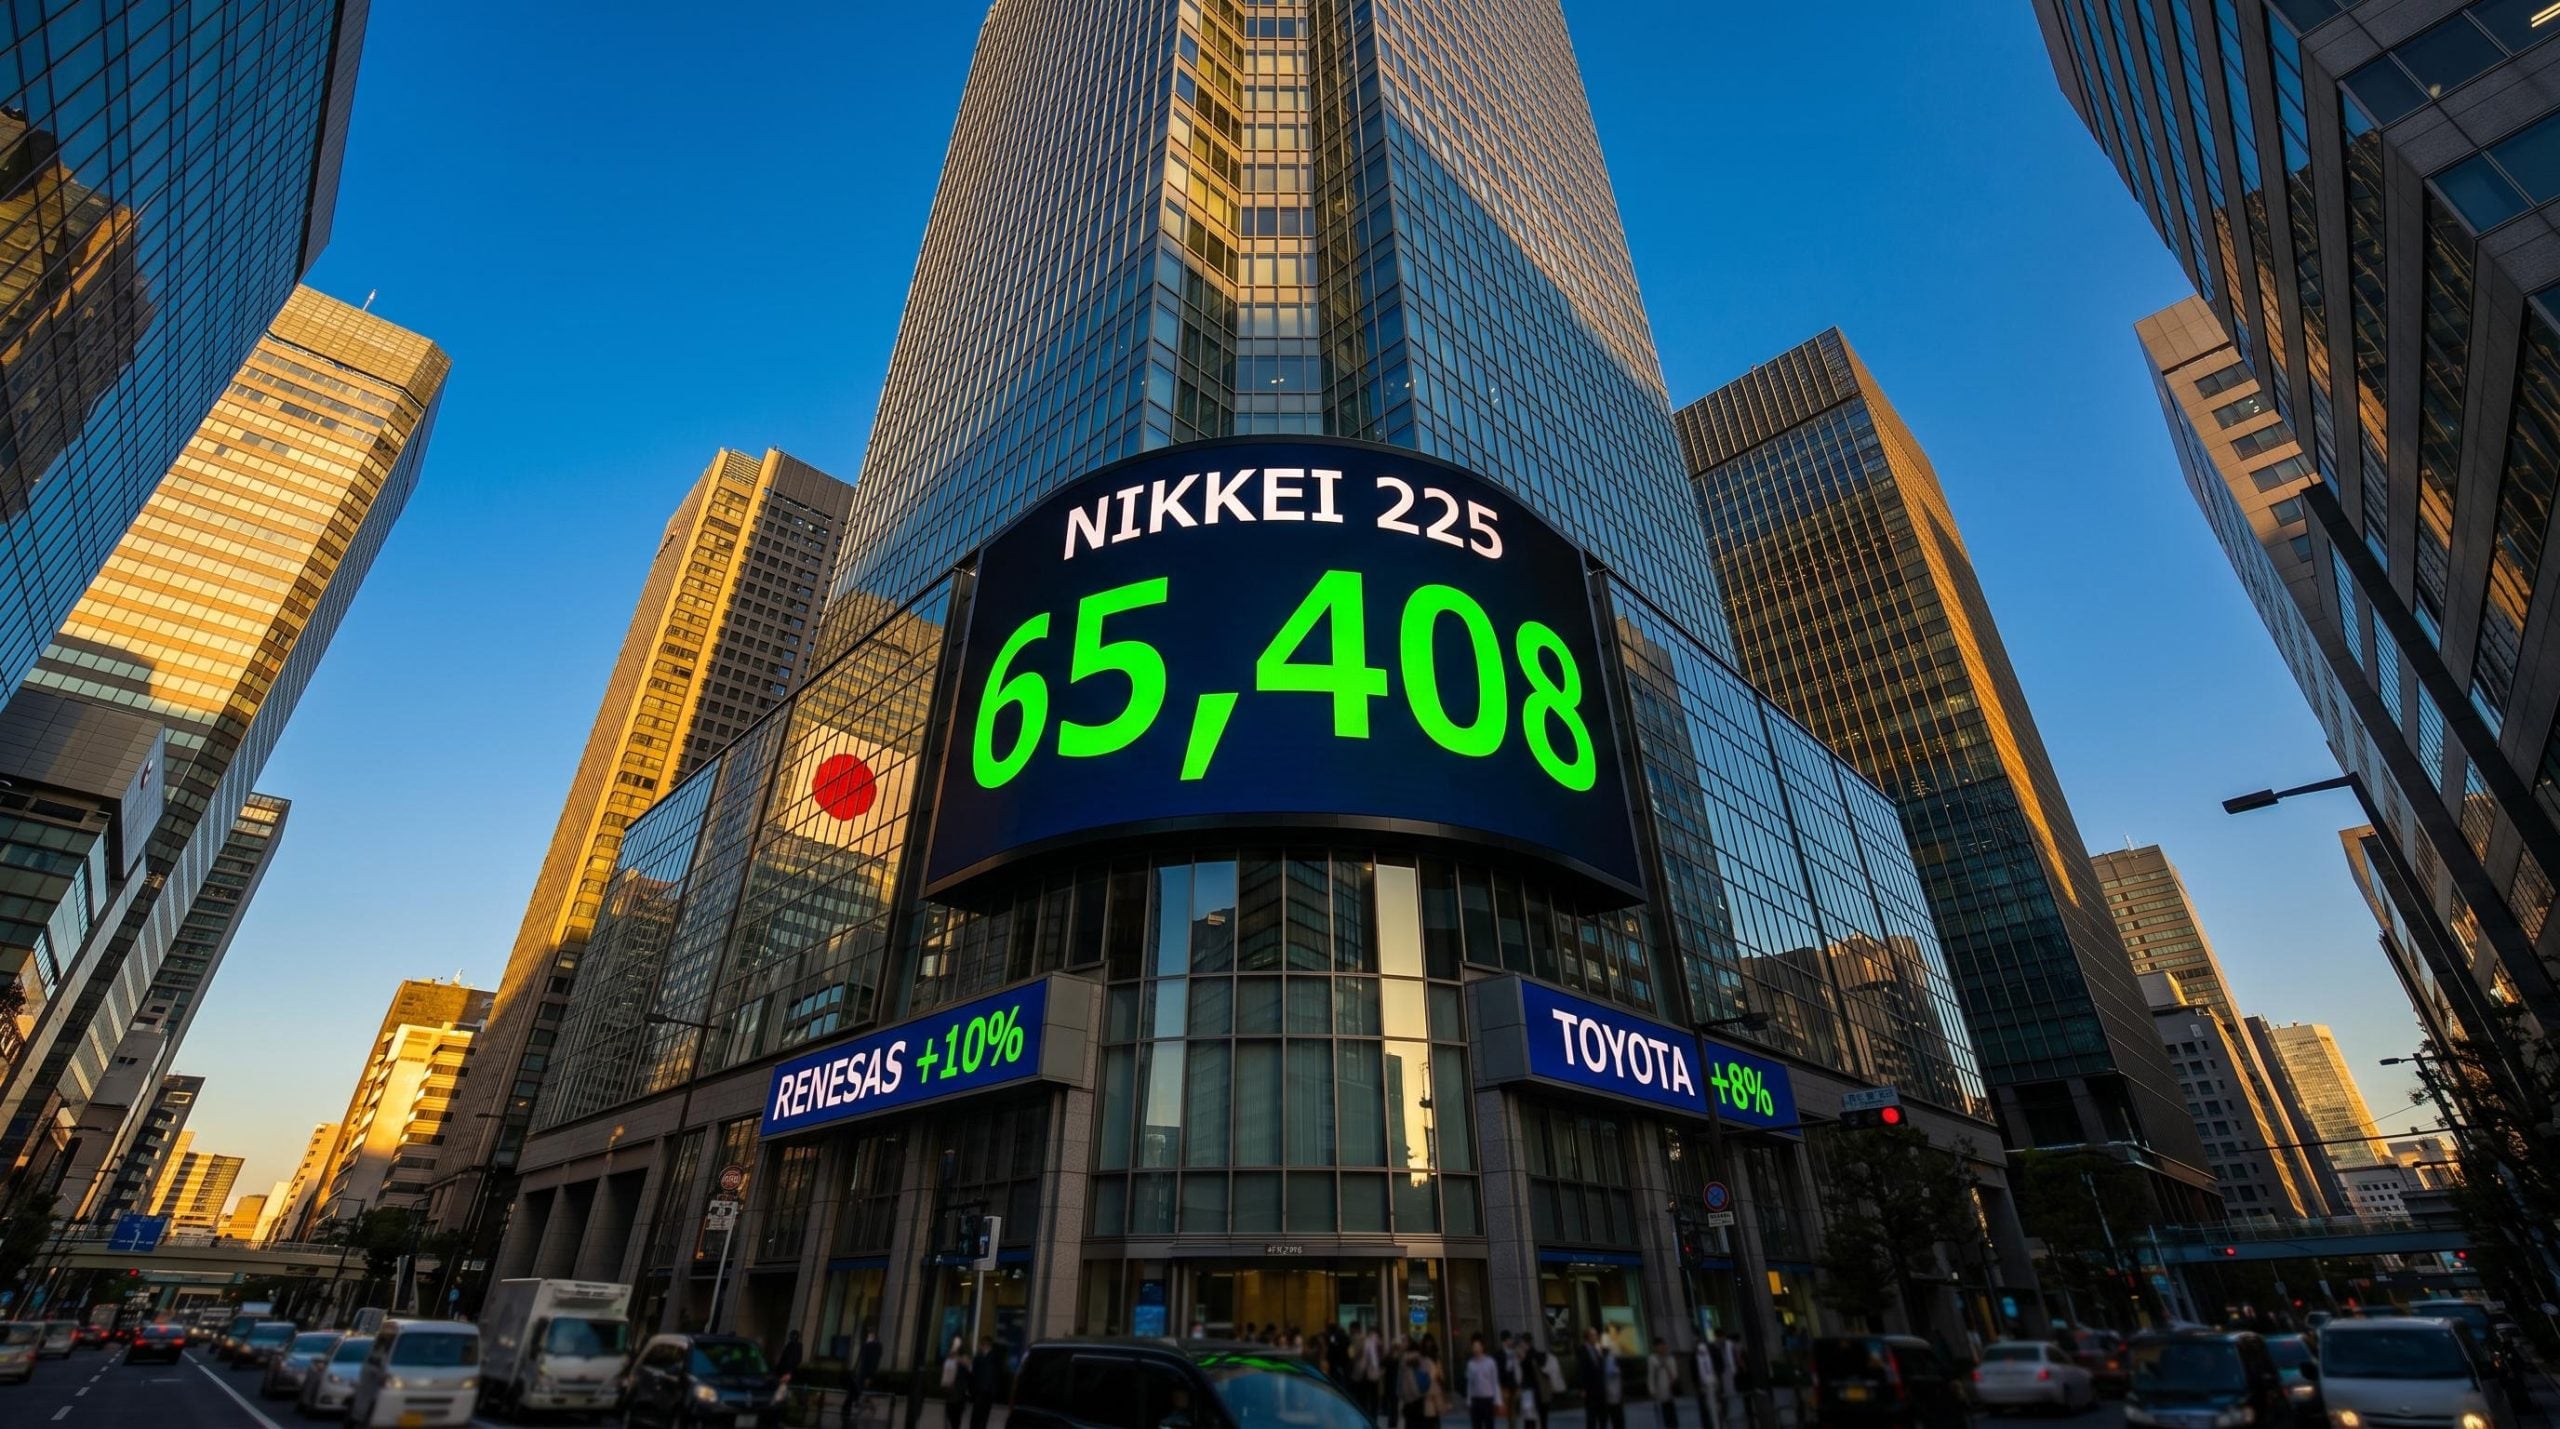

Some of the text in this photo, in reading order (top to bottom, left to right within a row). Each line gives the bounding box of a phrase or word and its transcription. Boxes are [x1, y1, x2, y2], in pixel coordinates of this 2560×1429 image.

[1063, 468, 1503, 561] NIKKEI 225
[972, 569, 1597, 792] 65,408
[772, 1005, 1025, 1121] RENESAS +10%
[1552, 1008, 1775, 1118] TOYOTA +8%
